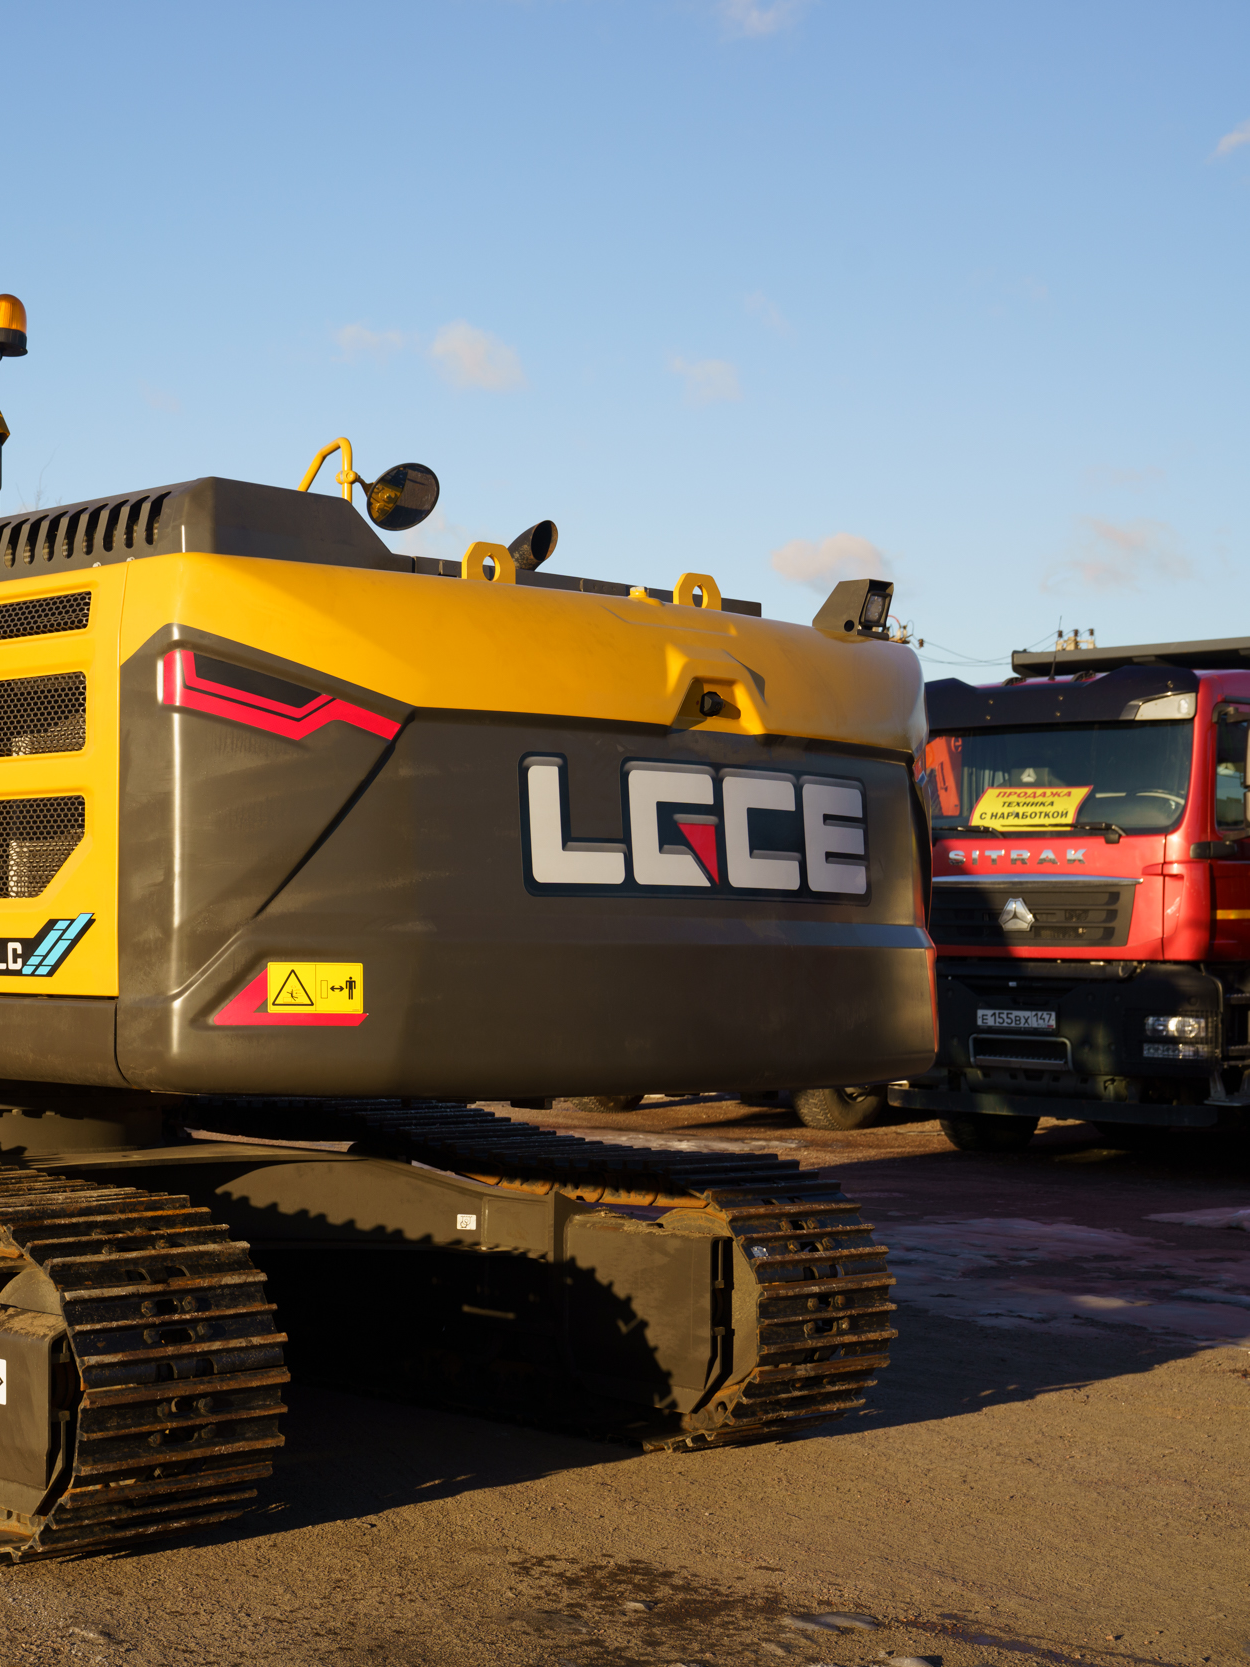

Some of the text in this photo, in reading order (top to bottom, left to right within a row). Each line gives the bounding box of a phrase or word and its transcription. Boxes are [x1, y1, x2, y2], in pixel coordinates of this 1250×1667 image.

[996, 790, 1072, 800] ПРОДАЖА
[1001, 800, 1055, 808] ТЕХНИКА
[979, 808, 1069, 820] С НАРАБОТКОЙ
[526, 764, 867, 895] LGCE
[948, 848, 1087, 865] SITRAK
